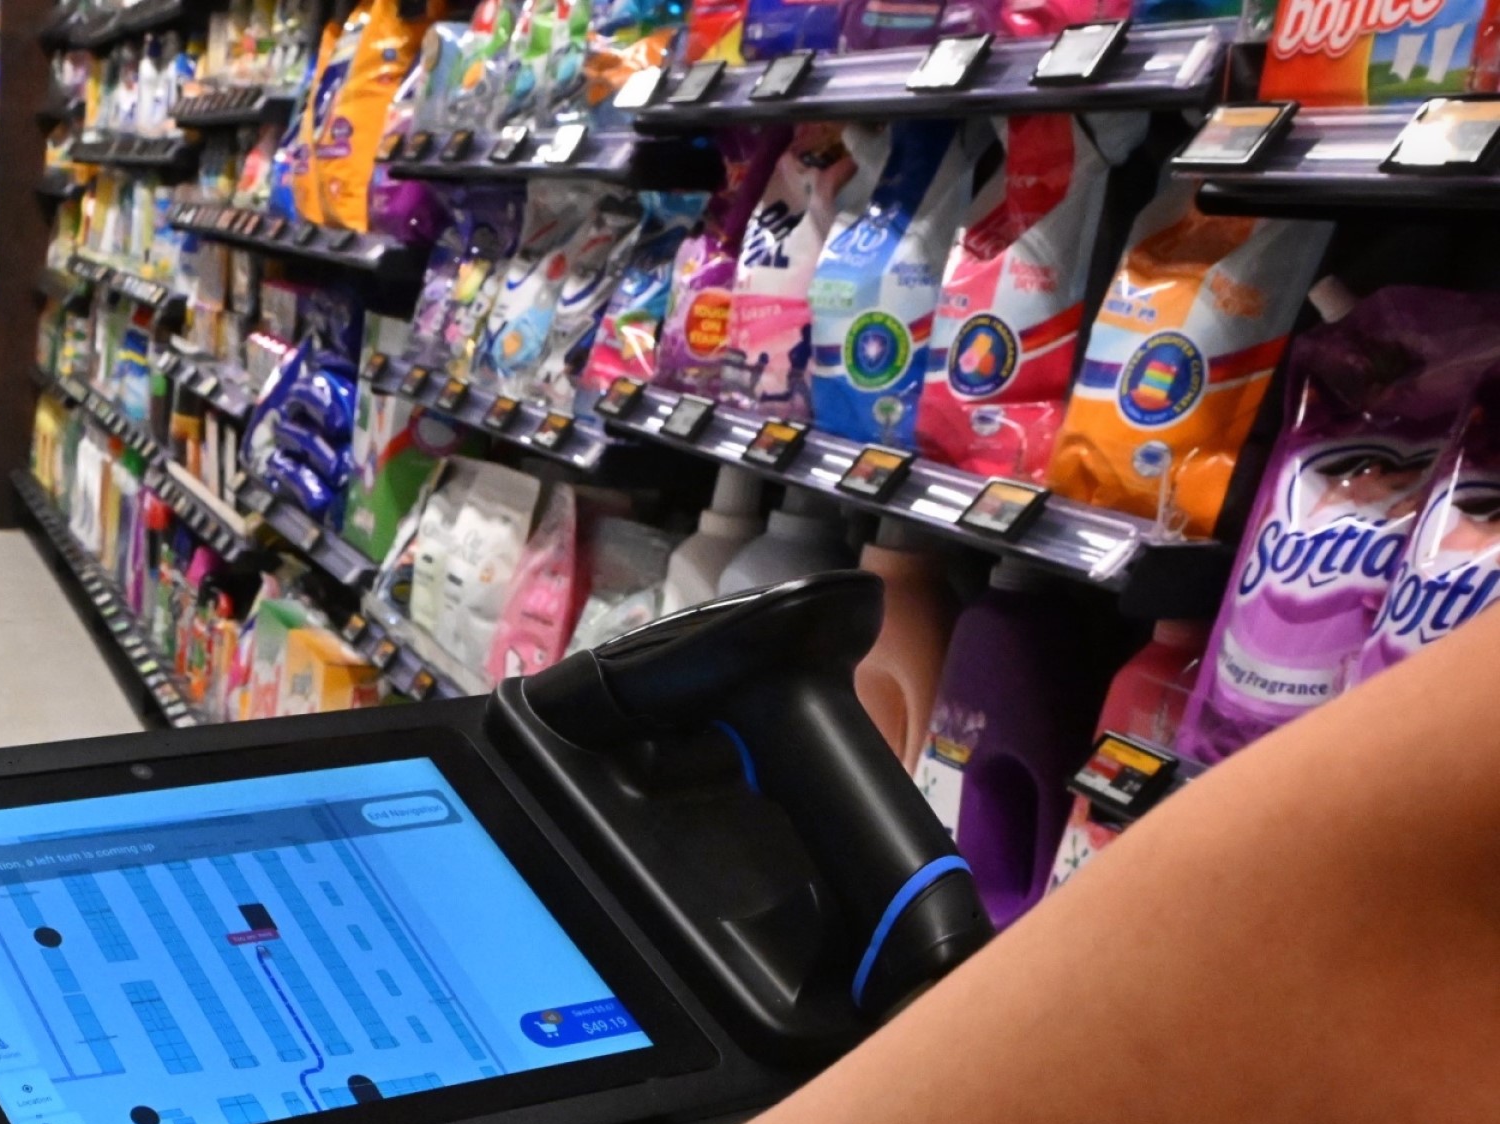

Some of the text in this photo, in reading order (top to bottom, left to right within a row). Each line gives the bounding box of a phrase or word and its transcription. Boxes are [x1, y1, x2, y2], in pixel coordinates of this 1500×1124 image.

[1239, 516, 1407, 595] Softla
[1245, 671, 1329, 695] Fragrance
[34, 854, 56, 866] left
[57, 853, 82, 863] turn
[81, 849, 95, 859] is
[95, 845, 139, 858] coming
[140, 842, 156, 853] up
[581, 1015, 628, 1036] $49.19
[16, 1095, 53, 1108] Location
